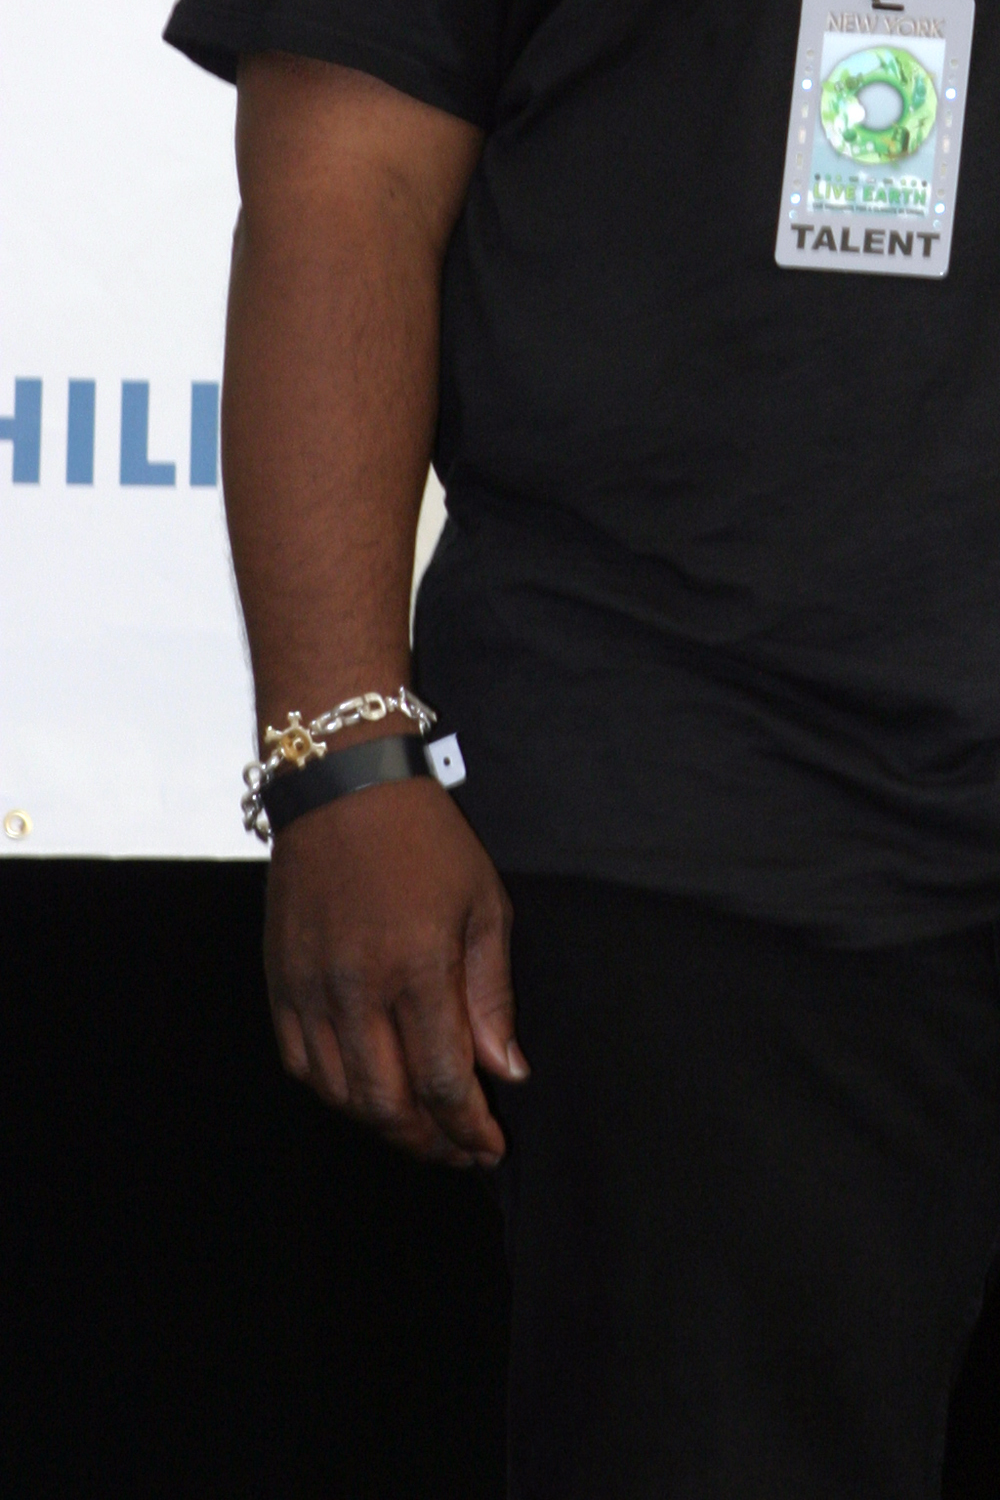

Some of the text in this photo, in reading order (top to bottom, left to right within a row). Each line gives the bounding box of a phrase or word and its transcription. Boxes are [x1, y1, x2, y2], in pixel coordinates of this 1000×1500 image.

[826, 11, 945, 40] NEW YORK
[812, 181, 928, 206] LIVE EARTH
[790, 222, 941, 259] TALENT
